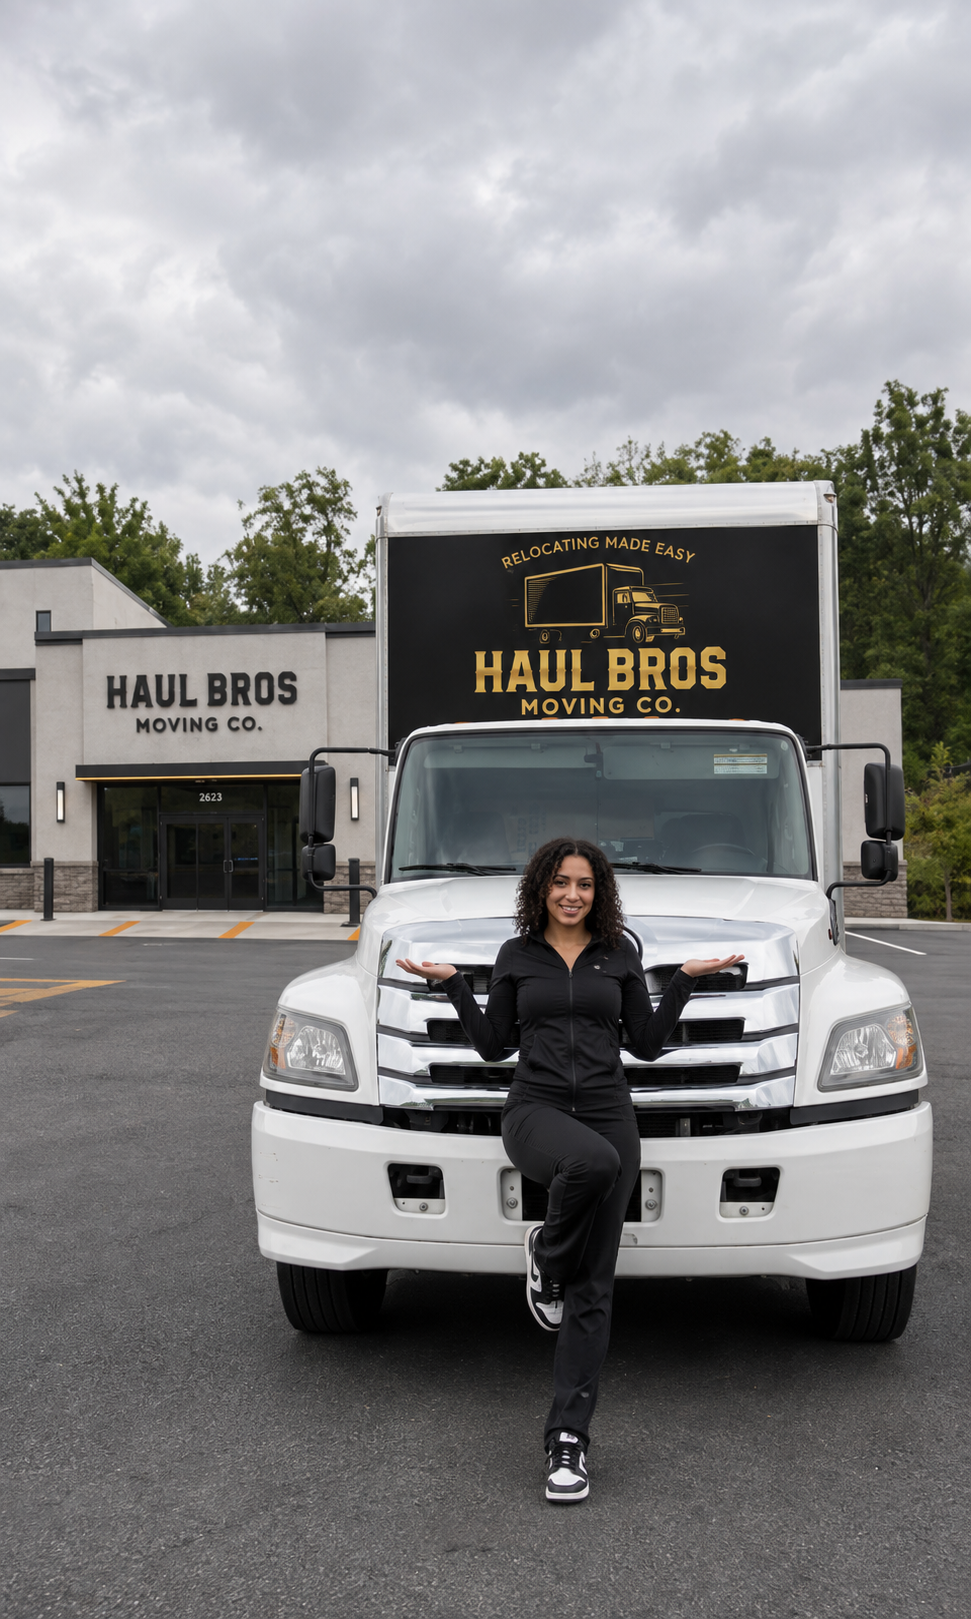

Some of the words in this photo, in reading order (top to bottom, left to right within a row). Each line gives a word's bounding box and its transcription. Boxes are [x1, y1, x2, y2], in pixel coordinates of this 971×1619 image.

[501, 536, 600, 569] RELOCATING
[605, 536, 651, 552] MADE
[655, 542, 696, 564] EASY
[474, 649, 595, 693] HAUL
[607, 646, 727, 691] BROS
[106, 673, 198, 709] HAUL
[207, 671, 298, 707] BROS
[521, 697, 625, 715] MOVING
[636, 696, 681, 714] CO.
[136, 716, 219, 733] MOVING
[227, 715, 263, 732] CO.
[199, 792, 223, 802] 2623
